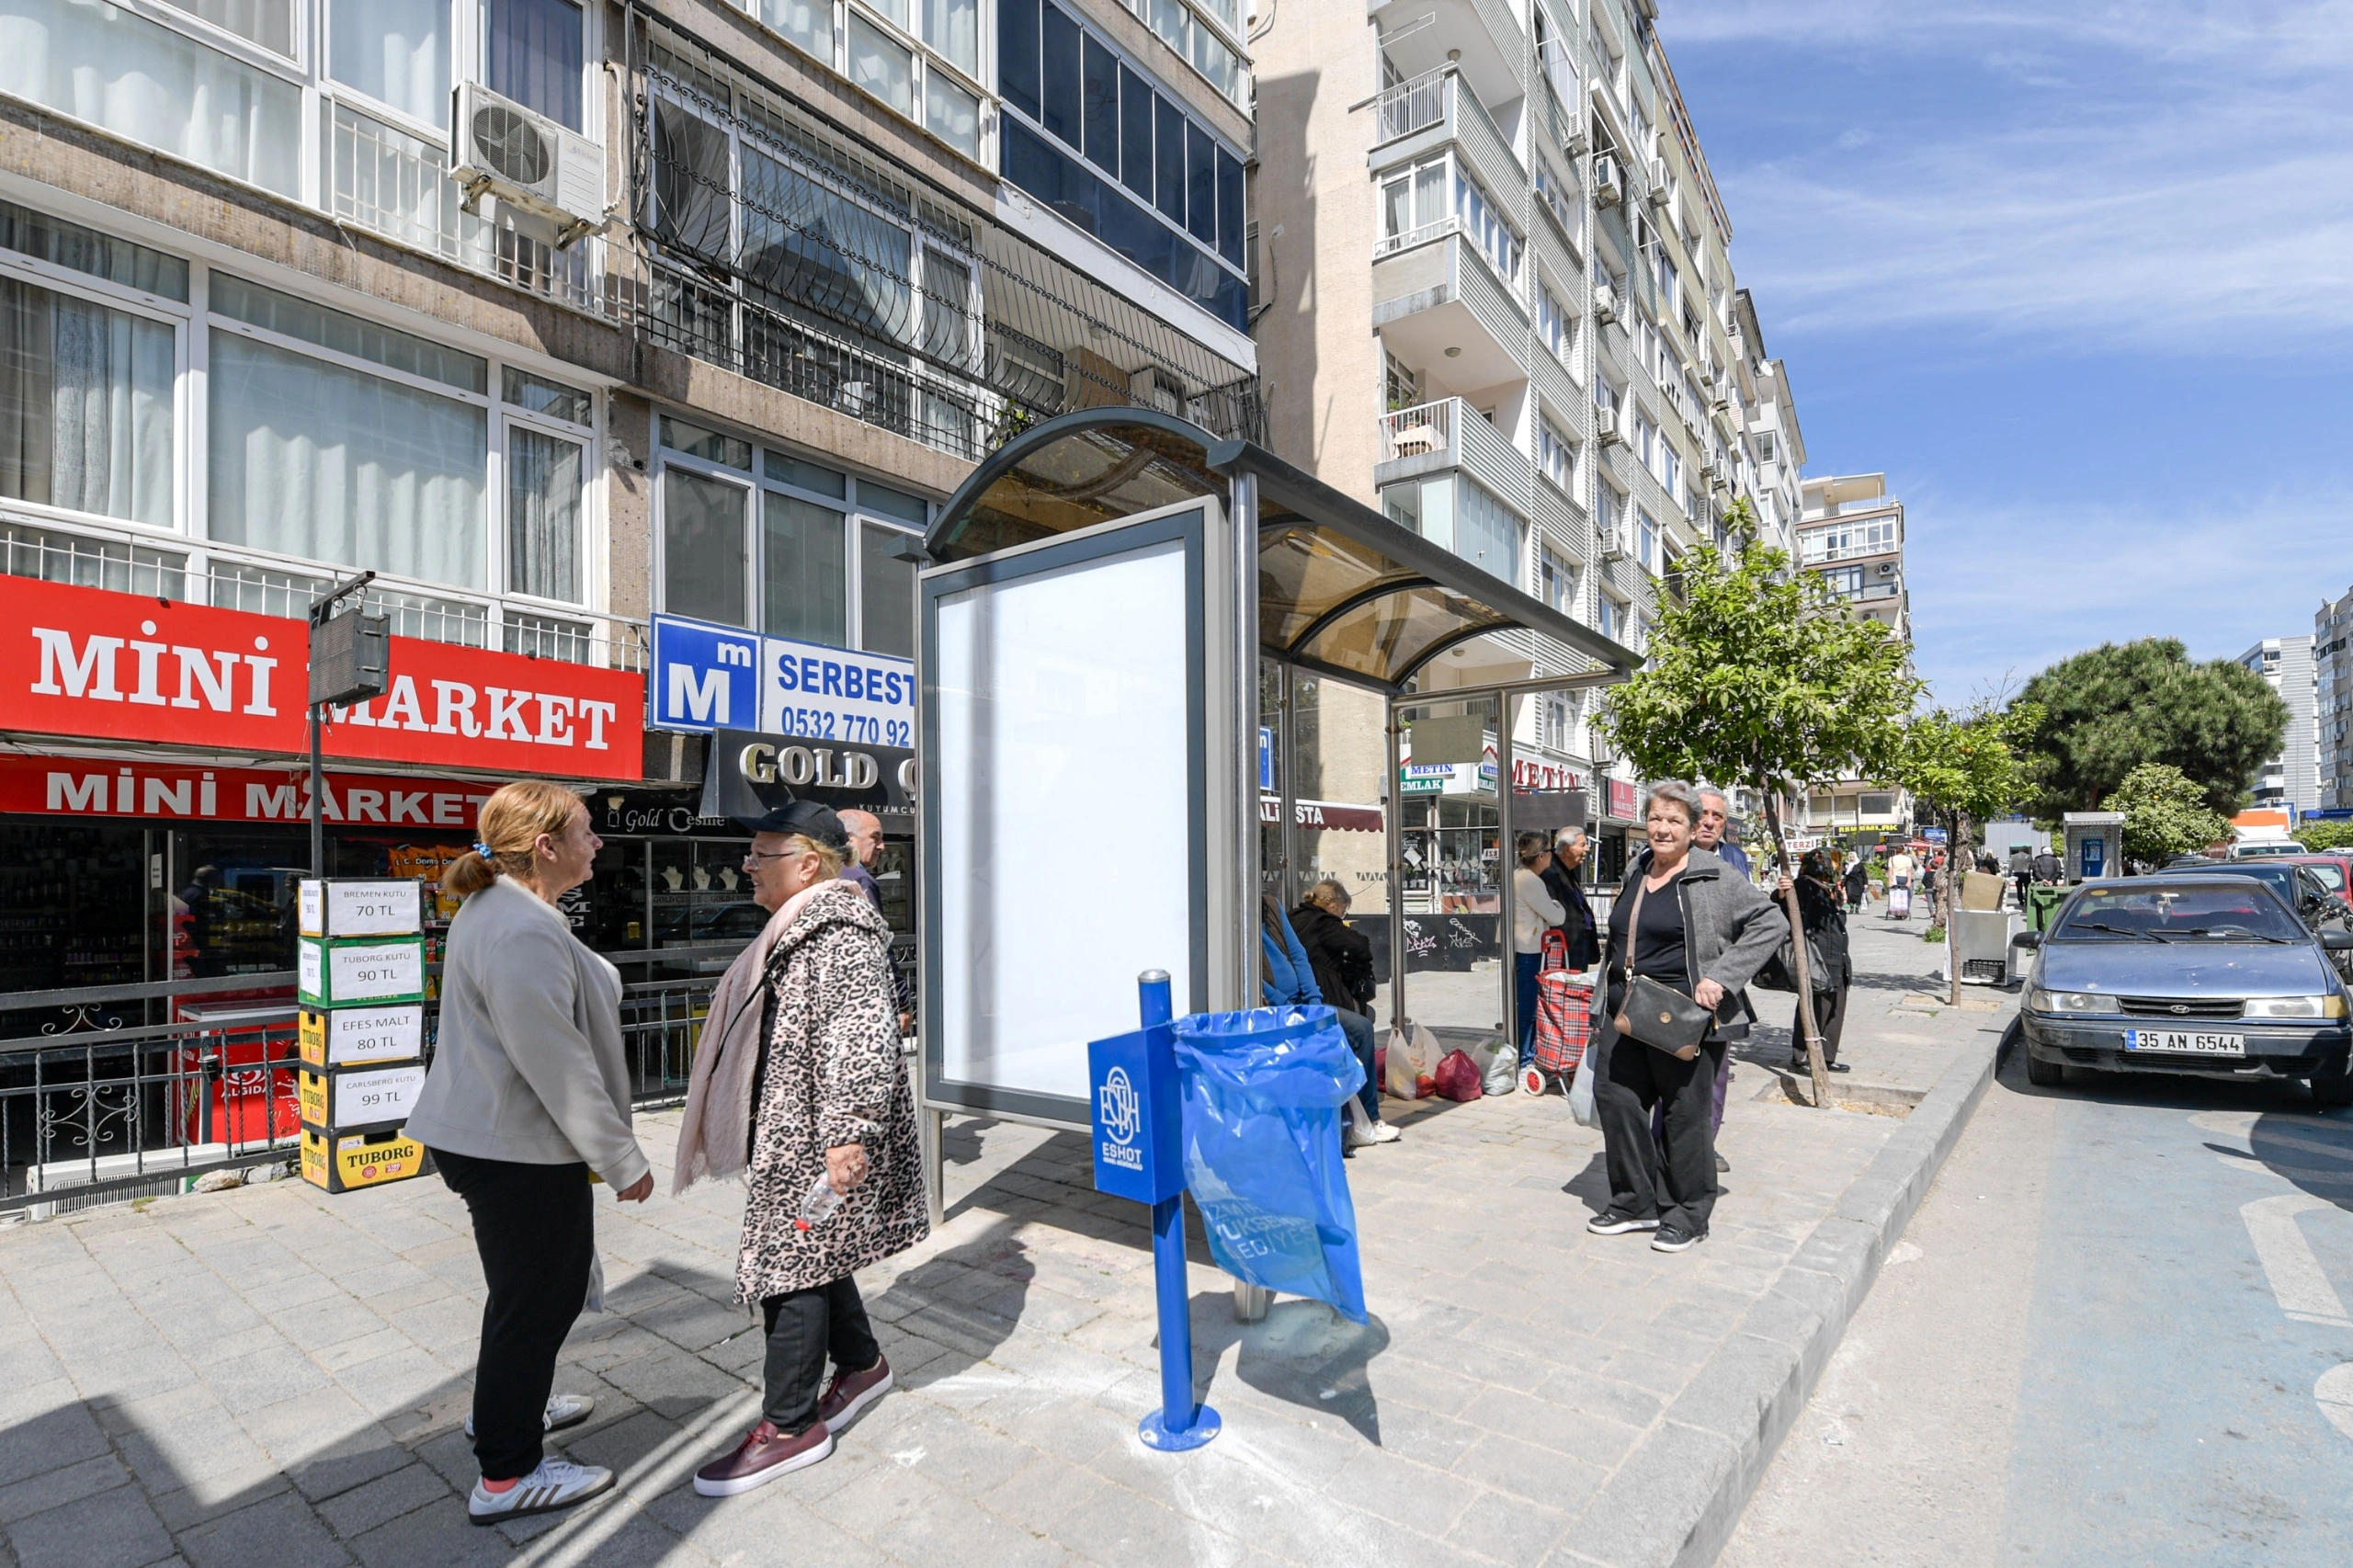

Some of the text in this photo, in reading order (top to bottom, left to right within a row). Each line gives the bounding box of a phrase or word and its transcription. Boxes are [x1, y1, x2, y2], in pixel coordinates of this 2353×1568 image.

[30, 619, 278, 717] MİNİ
[779, 653, 915, 707] SERBEST
[668, 663, 730, 723] M
[781, 707, 910, 747] 0532 770 92
[739, 743, 879, 790] GOLD
[47, 767, 217, 816] MİNİ
[1401, 779, 1442, 791] EMLAK
[625, 808, 664, 833] Gold
[343, 890, 381, 899] BREMEN
[356, 905, 396, 917] 70 TL
[343, 952, 411, 964] TUBORG KUTU
[358, 969, 397, 983] 90 TL
[342, 1016, 411, 1031] EFES MALT
[358, 1036, 397, 1050] 80 TL
[2139, 1032, 2240, 1051] 35 AN 6544
[347, 1075, 416, 1090] CARLSBERG KUTU
[362, 1092, 402, 1106] 99 TL
[347, 1145, 414, 1168] TUBORG
[1102, 1142, 1142, 1164] ESHOT
